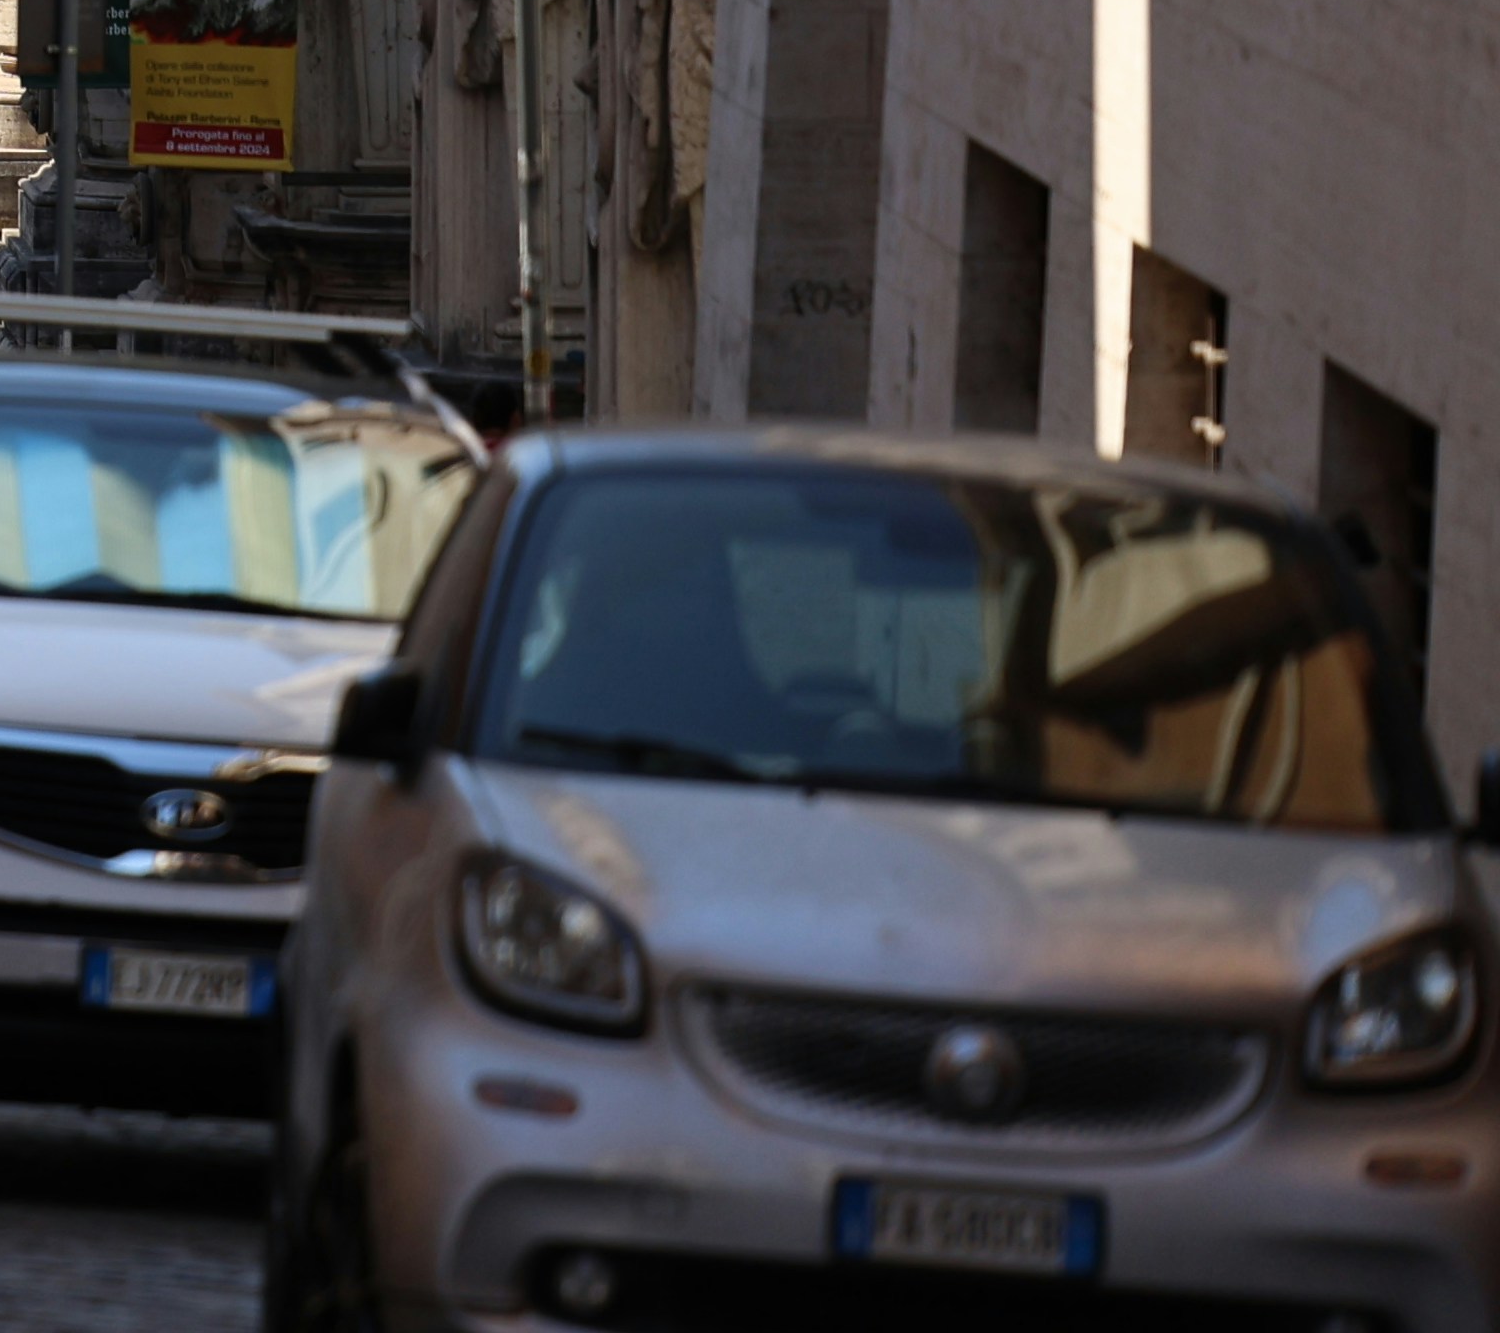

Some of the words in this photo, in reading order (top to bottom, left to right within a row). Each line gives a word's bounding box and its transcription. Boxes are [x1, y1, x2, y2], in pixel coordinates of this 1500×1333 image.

[171, 126, 230, 142] Prorogata
[232, 129, 252, 141] fino
[177, 143, 237, 154] settembre
[238, 143, 270, 156] 2024
